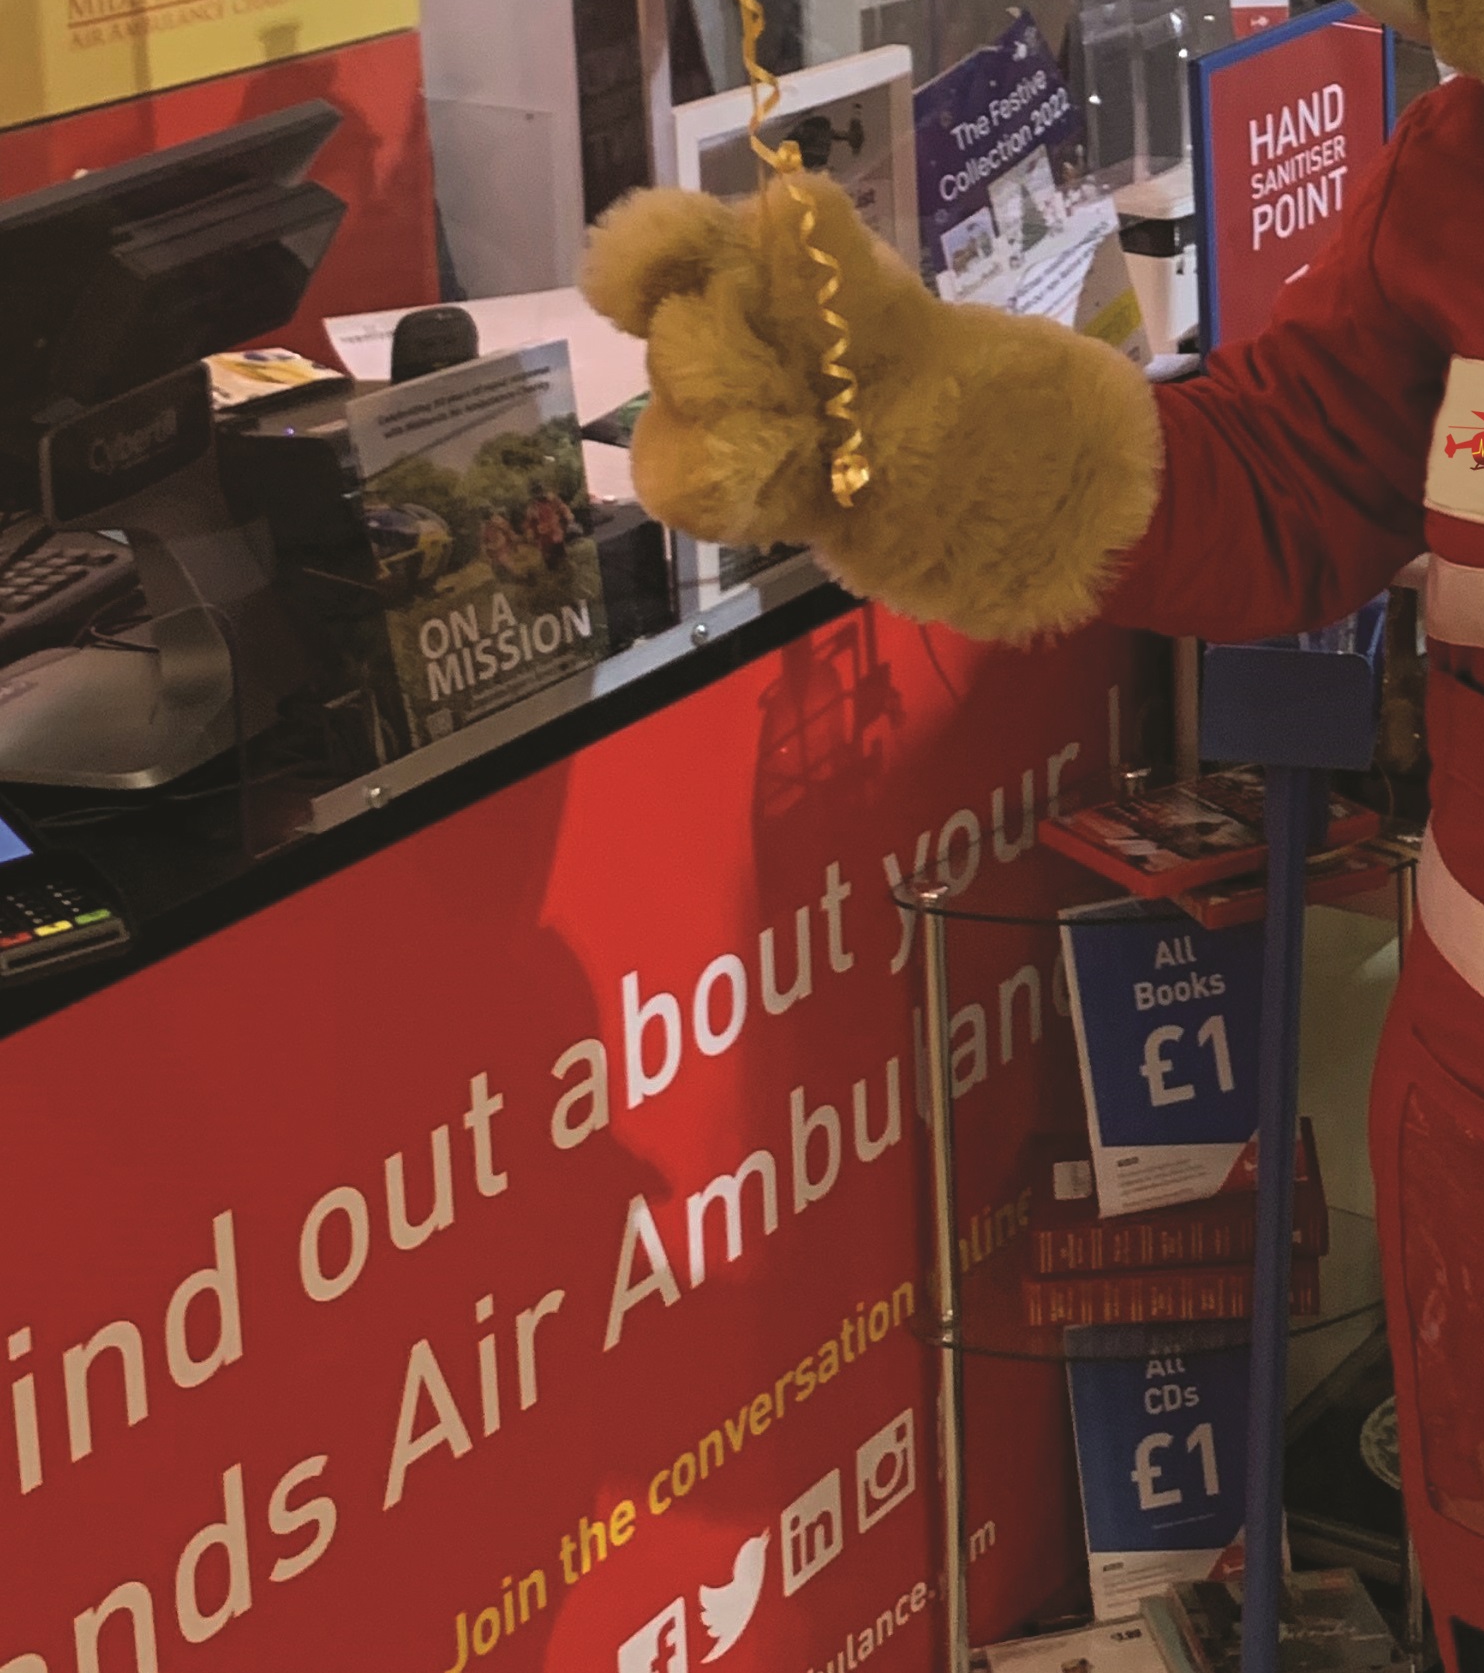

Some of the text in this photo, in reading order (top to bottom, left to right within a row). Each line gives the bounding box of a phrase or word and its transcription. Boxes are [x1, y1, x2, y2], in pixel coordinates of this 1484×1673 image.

[939, 86, 1071, 201] Collection 2022
[950, 69, 1048, 151] The Festive
[1249, 83, 1345, 167] HAND
[1251, 134, 1346, 200] SANITISER
[1252, 165, 1348, 252] POINT
[419, 591, 519, 660] ON A
[426, 598, 593, 702] MISSION
[1132, 971, 1227, 1012] Books
[1154, 934, 1198, 970] All
[1138, 1013, 1235, 1108] £1
[8, 740, 1080, 1495] ind out about your
[382, 1289, 566, 1512] Air
[1143, 1383, 1201, 1416] CDs
[1145, 1346, 1187, 1380] All
[443, 1564, 548, 1673] Join
[558, 1498, 638, 1587] the
[646, 1280, 917, 1517] conversation
[1130, 1421, 1221, 1511] £1
